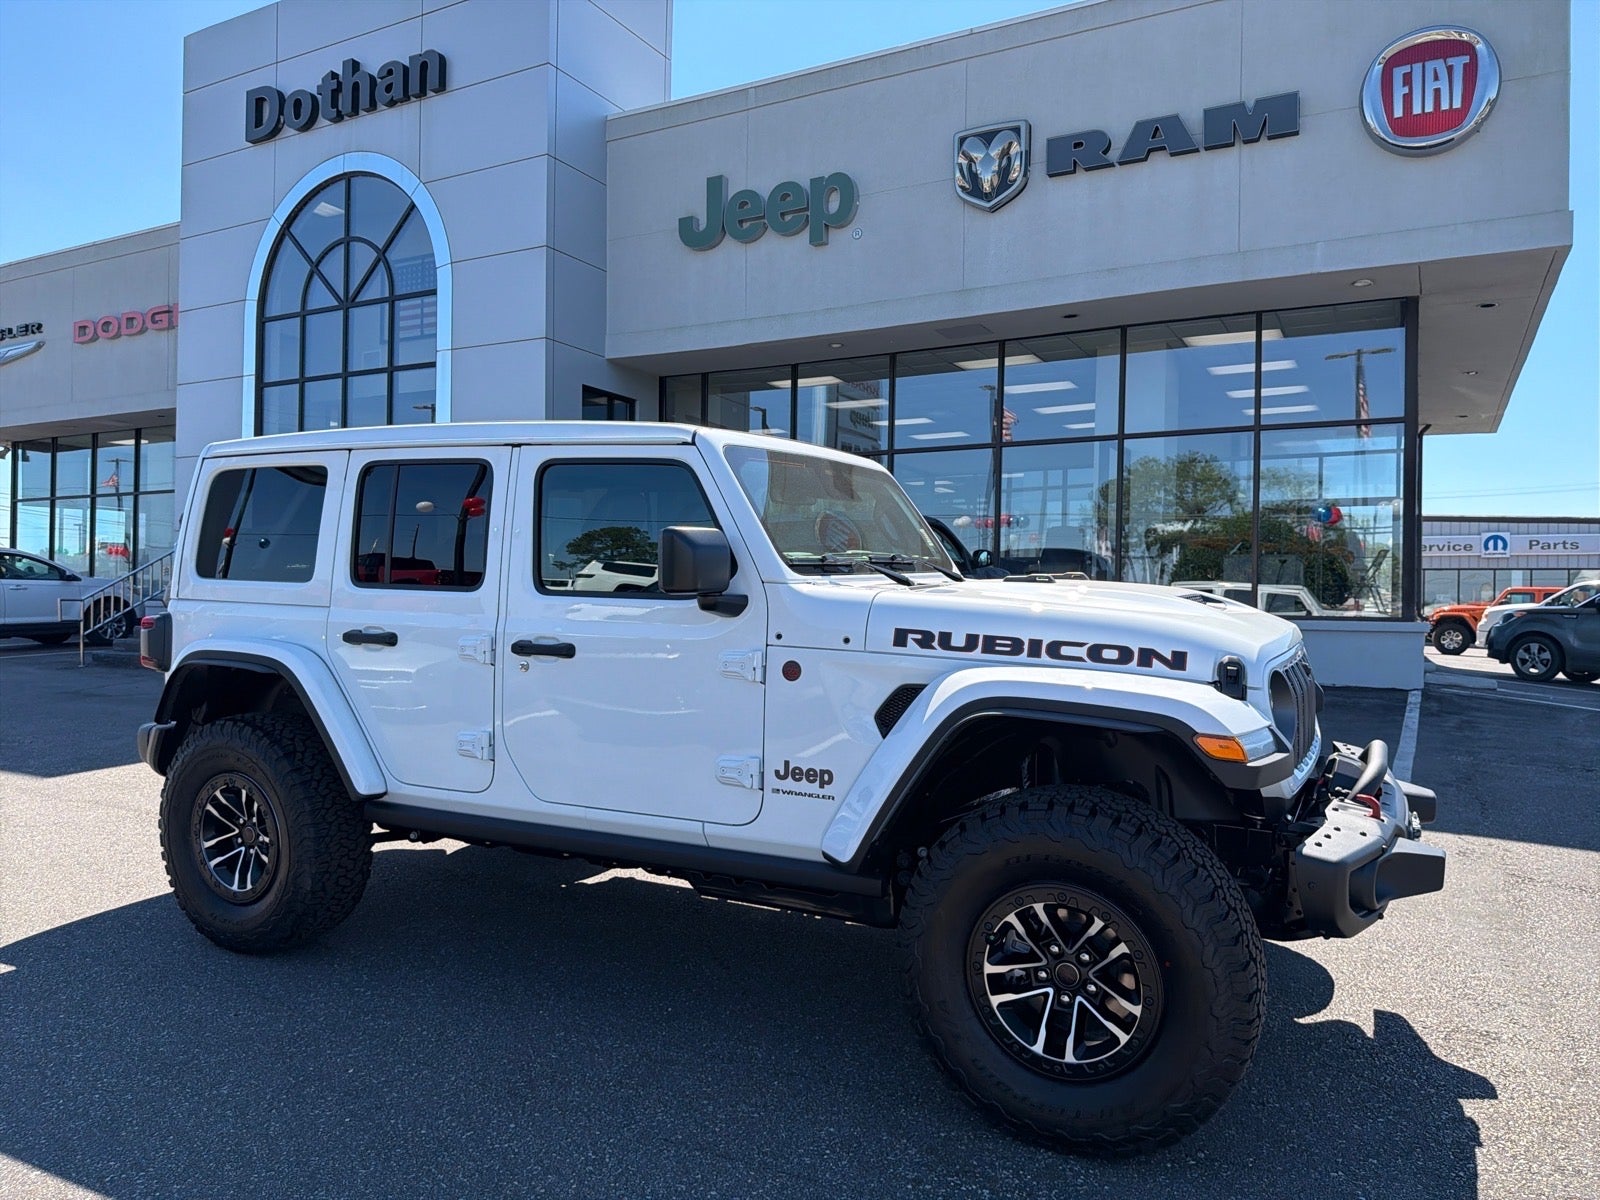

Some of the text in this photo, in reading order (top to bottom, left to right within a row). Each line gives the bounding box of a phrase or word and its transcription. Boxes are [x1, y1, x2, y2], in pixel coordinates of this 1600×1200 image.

[245, 49, 447, 144] Dothan
[1392, 55, 1470, 119] FIAT
[1046, 90, 1300, 178] RAM
[678, 171, 860, 251] Jeep
[1528, 540, 1579, 550] Parts
[892, 627, 1188, 671] RUBICON
[774, 759, 834, 789] Jeep
[781, 788, 835, 801] WRANGLER
